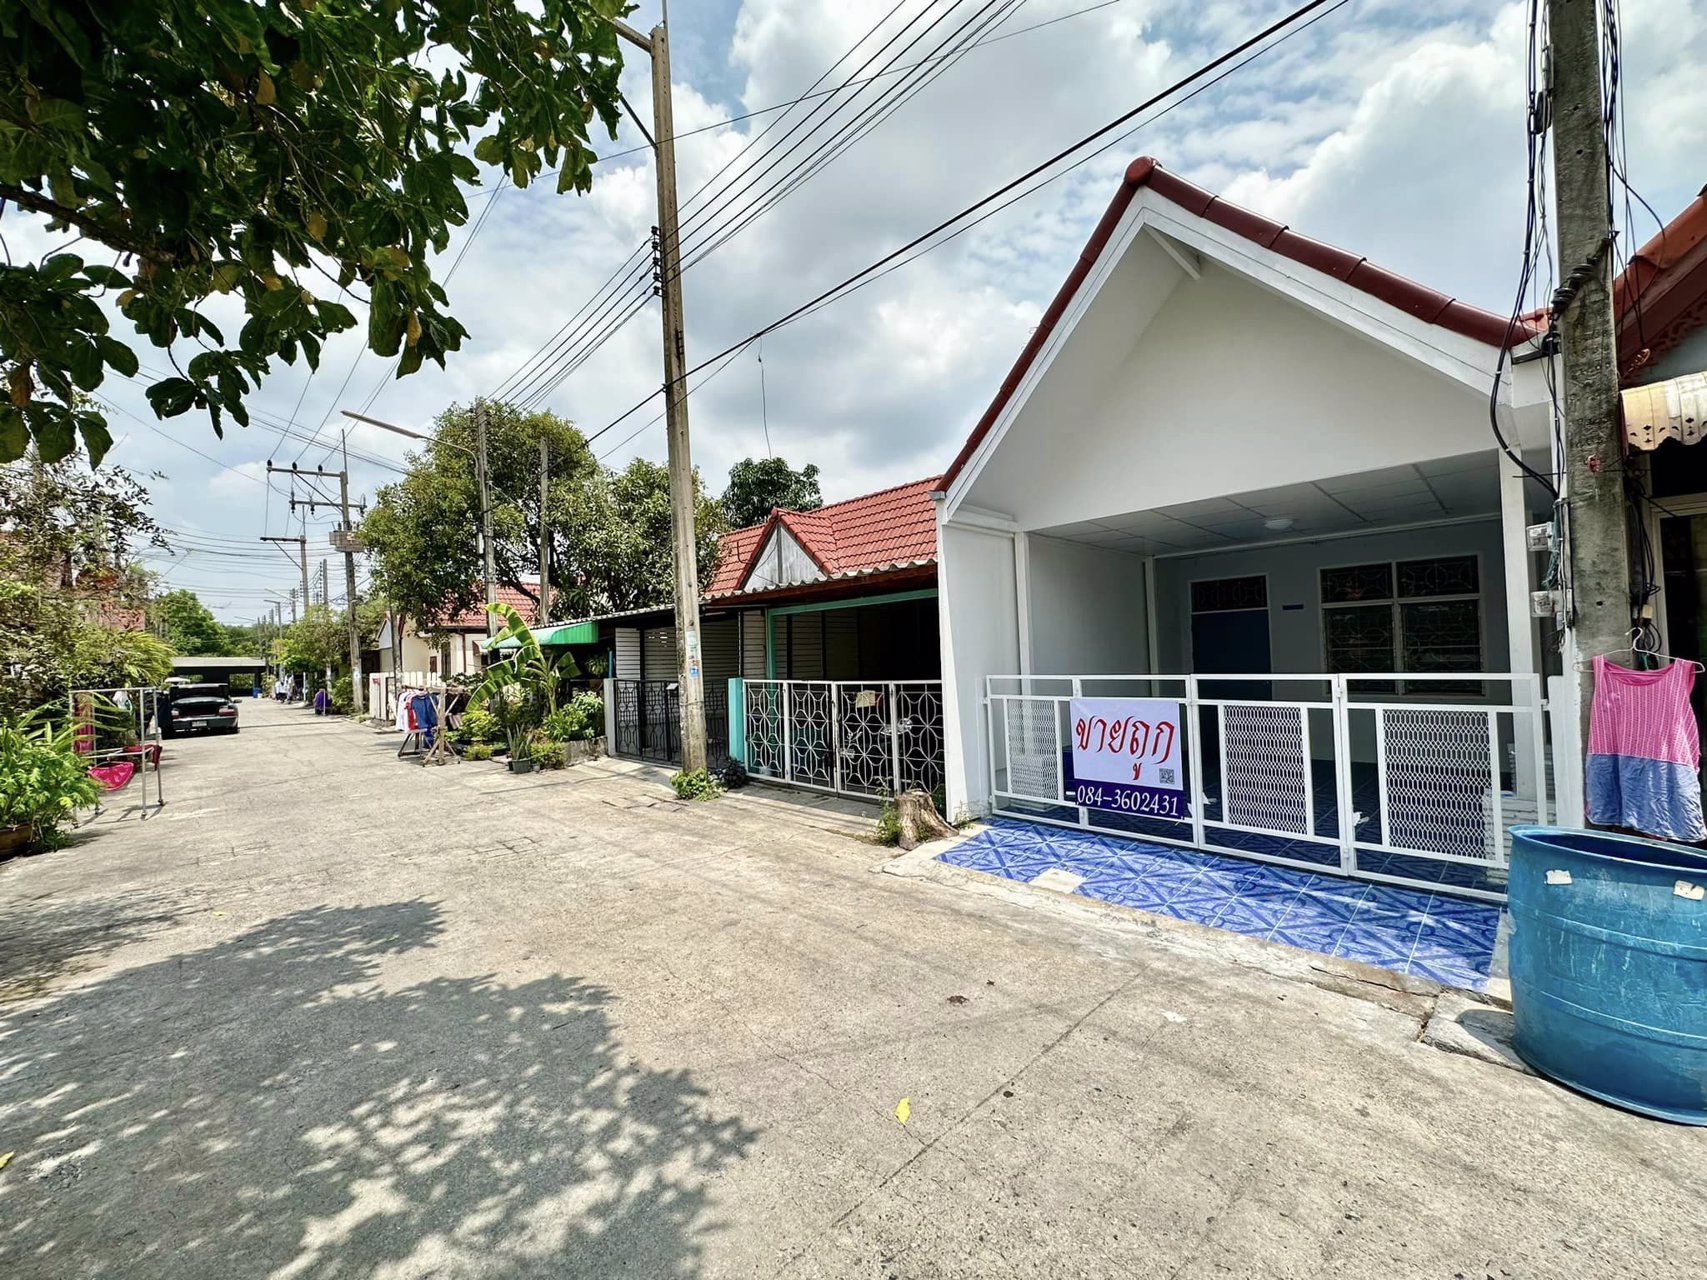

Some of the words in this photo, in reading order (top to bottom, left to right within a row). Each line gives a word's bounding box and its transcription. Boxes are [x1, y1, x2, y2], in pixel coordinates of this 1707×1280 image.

[1075, 715, 1175, 781] ขายถูก
[1077, 784, 1179, 816] 084-3602431
